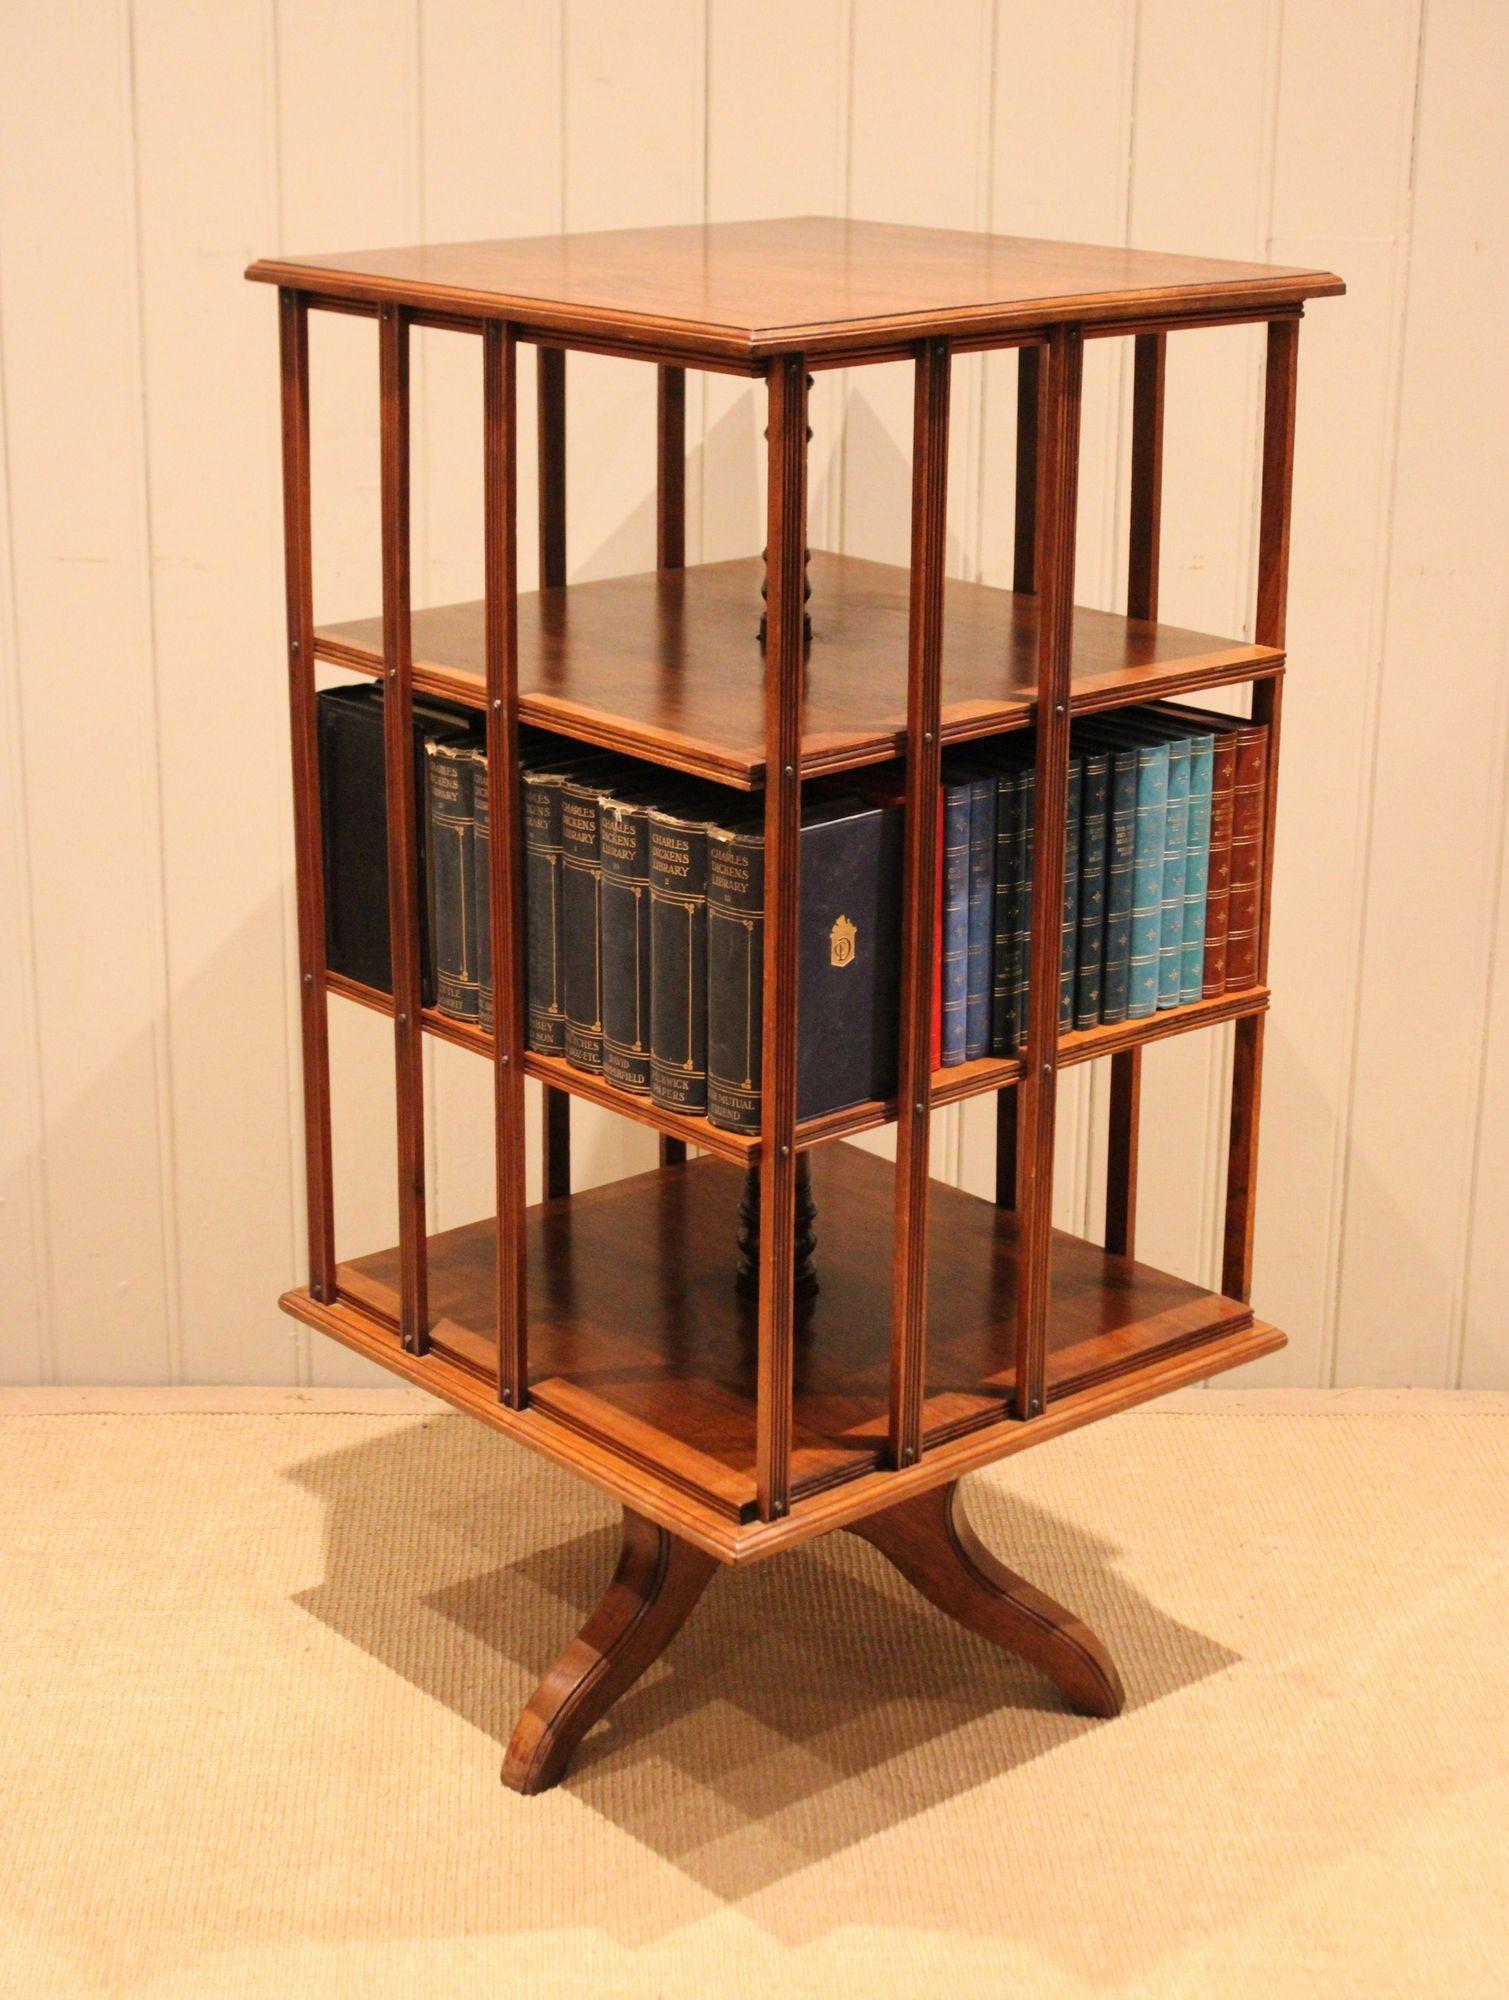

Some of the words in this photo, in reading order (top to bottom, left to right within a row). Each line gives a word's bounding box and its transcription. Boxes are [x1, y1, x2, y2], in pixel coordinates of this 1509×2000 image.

[601, 829, 637, 848] DICKENS
[651, 833, 689, 851] CHARLES
[601, 843, 637, 861] LIBRARY
[651, 846, 690, 864] DICKENS
[710, 848, 749, 867] CHARLES
[652, 859, 690, 877] LIBRARY
[711, 860, 749, 880] DICKENS
[711, 873, 749, 893] LIBRARY
[719, 1093, 755, 1111] MUTUAL
